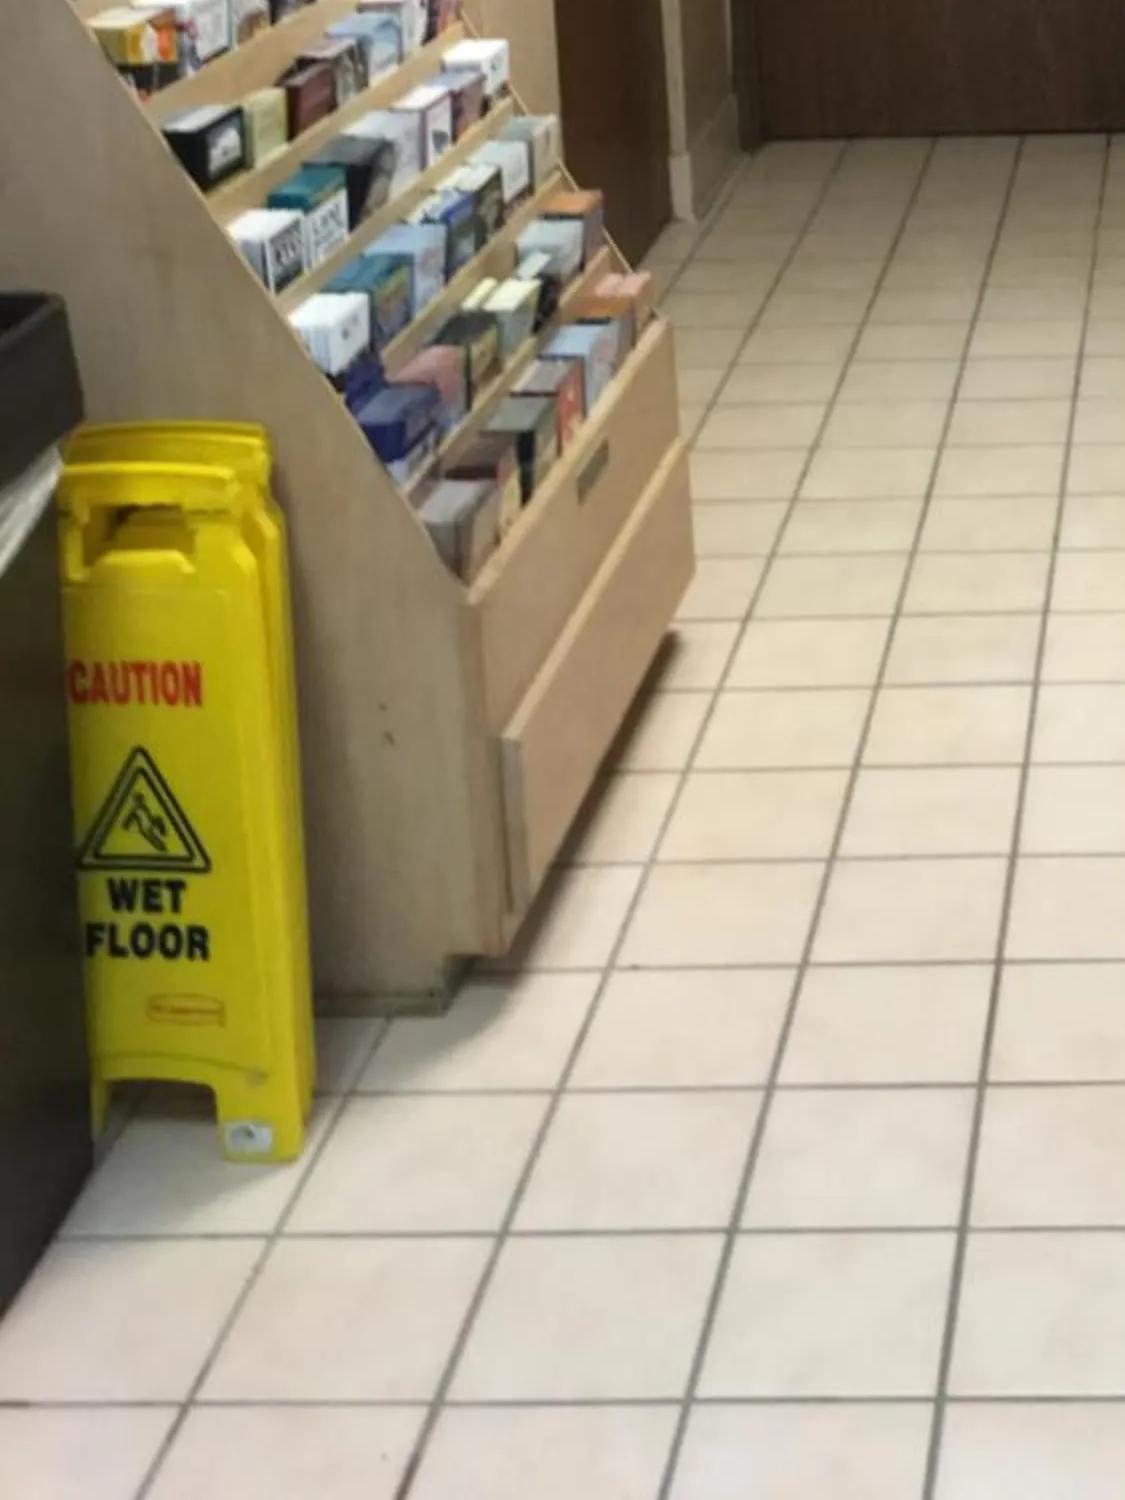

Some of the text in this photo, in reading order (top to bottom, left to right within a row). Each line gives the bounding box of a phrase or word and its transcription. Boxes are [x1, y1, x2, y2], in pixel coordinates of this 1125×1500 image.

[67, 659, 203, 707] CAUTION
[107, 877, 187, 914] WET
[84, 921, 210, 961] FLOOR
